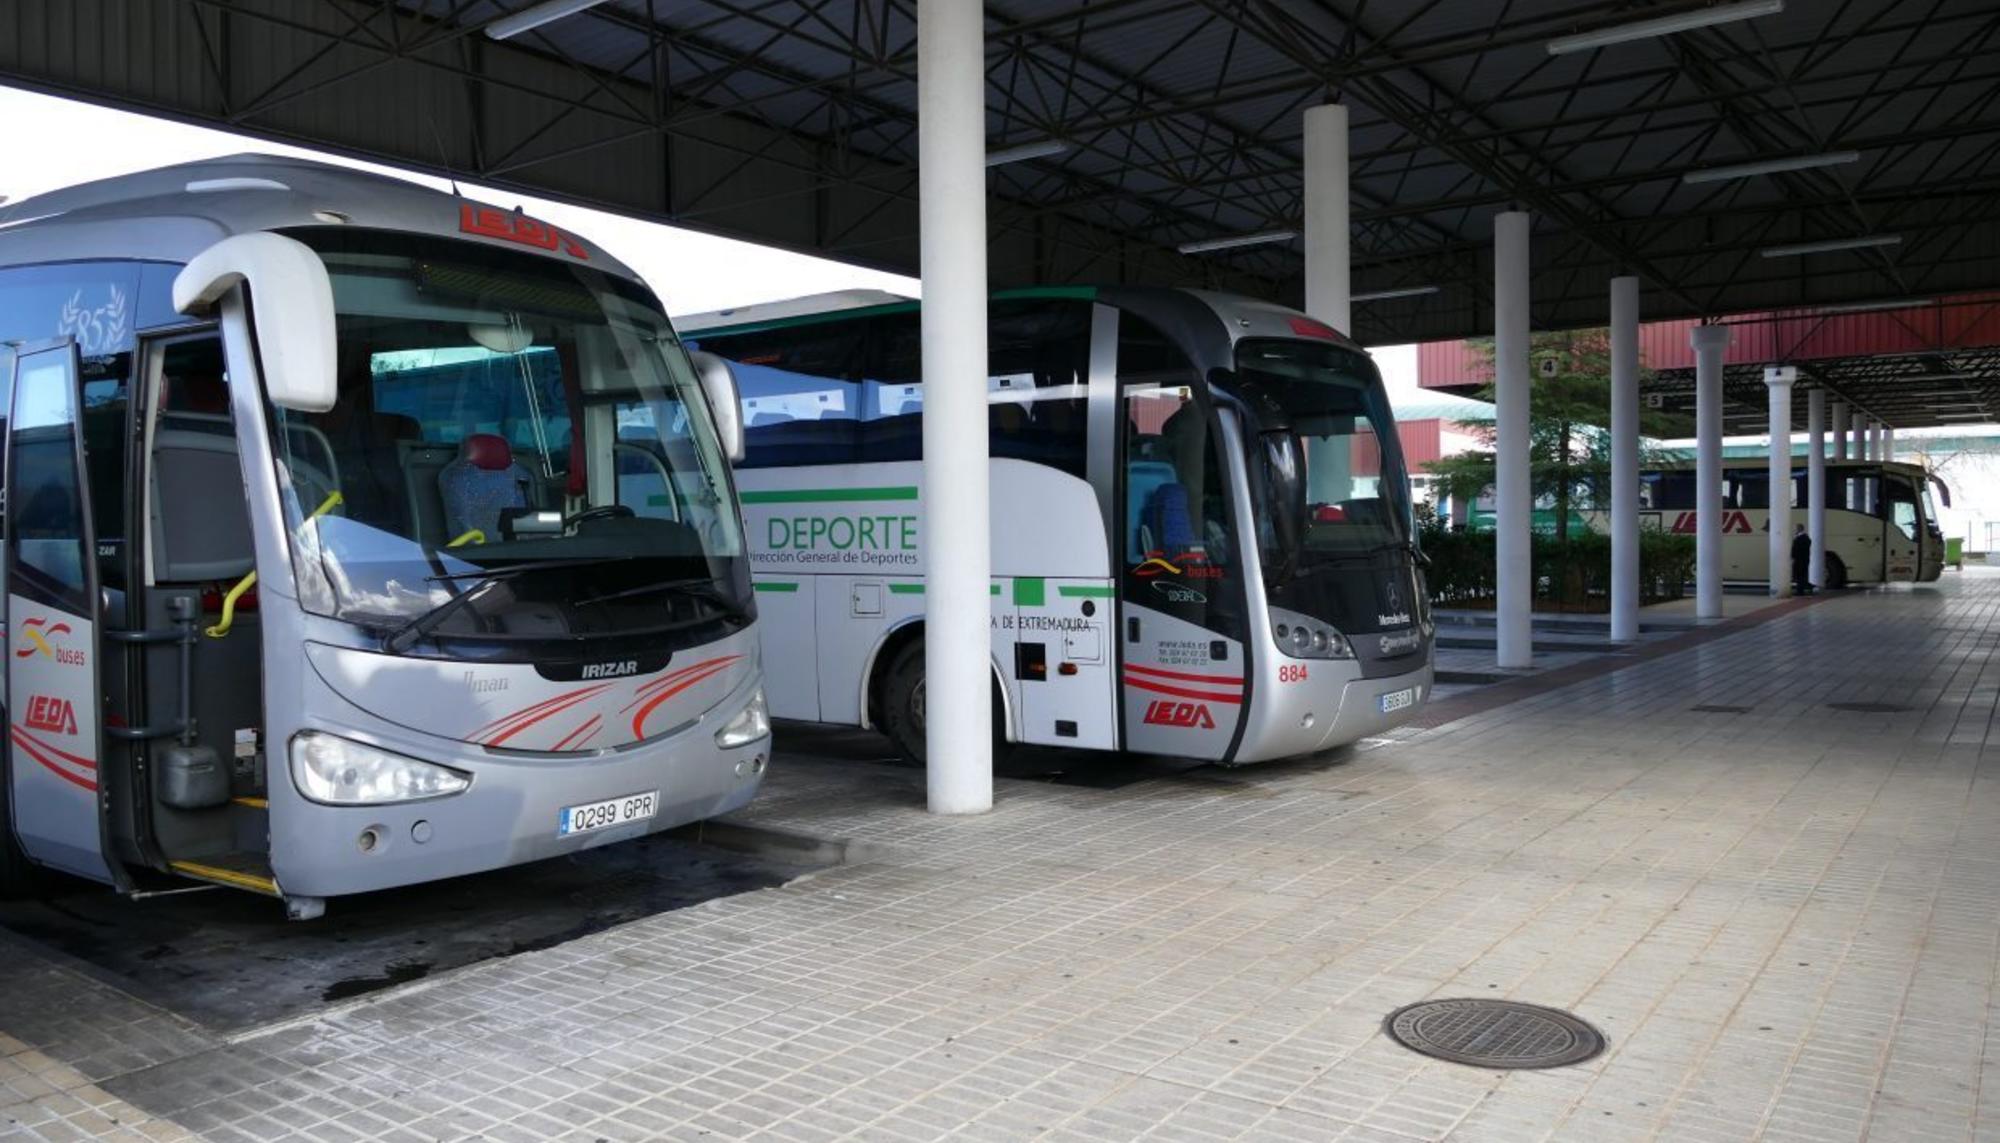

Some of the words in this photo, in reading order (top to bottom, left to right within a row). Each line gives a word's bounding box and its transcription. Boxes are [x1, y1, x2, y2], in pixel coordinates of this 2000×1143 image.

[78, 307, 105, 352] 85
[1543, 360, 1553, 373] 4
[768, 516, 917, 550] DEPORTE
[796, 551, 841, 563] General
[843, 551, 859, 563] de
[861, 552, 918, 565] Deportes
[1002, 615, 1014, 629] DE
[1019, 616, 1091, 632] EXTREMADURA
[581, 661, 638, 679] IRIZAR
[1279, 664, 1308, 682] 884
[25, 695, 78, 736] LEDA
[1143, 701, 1216, 730] LEDA
[575, 804, 617, 830] 0299
[624, 796, 652, 819] GPR
